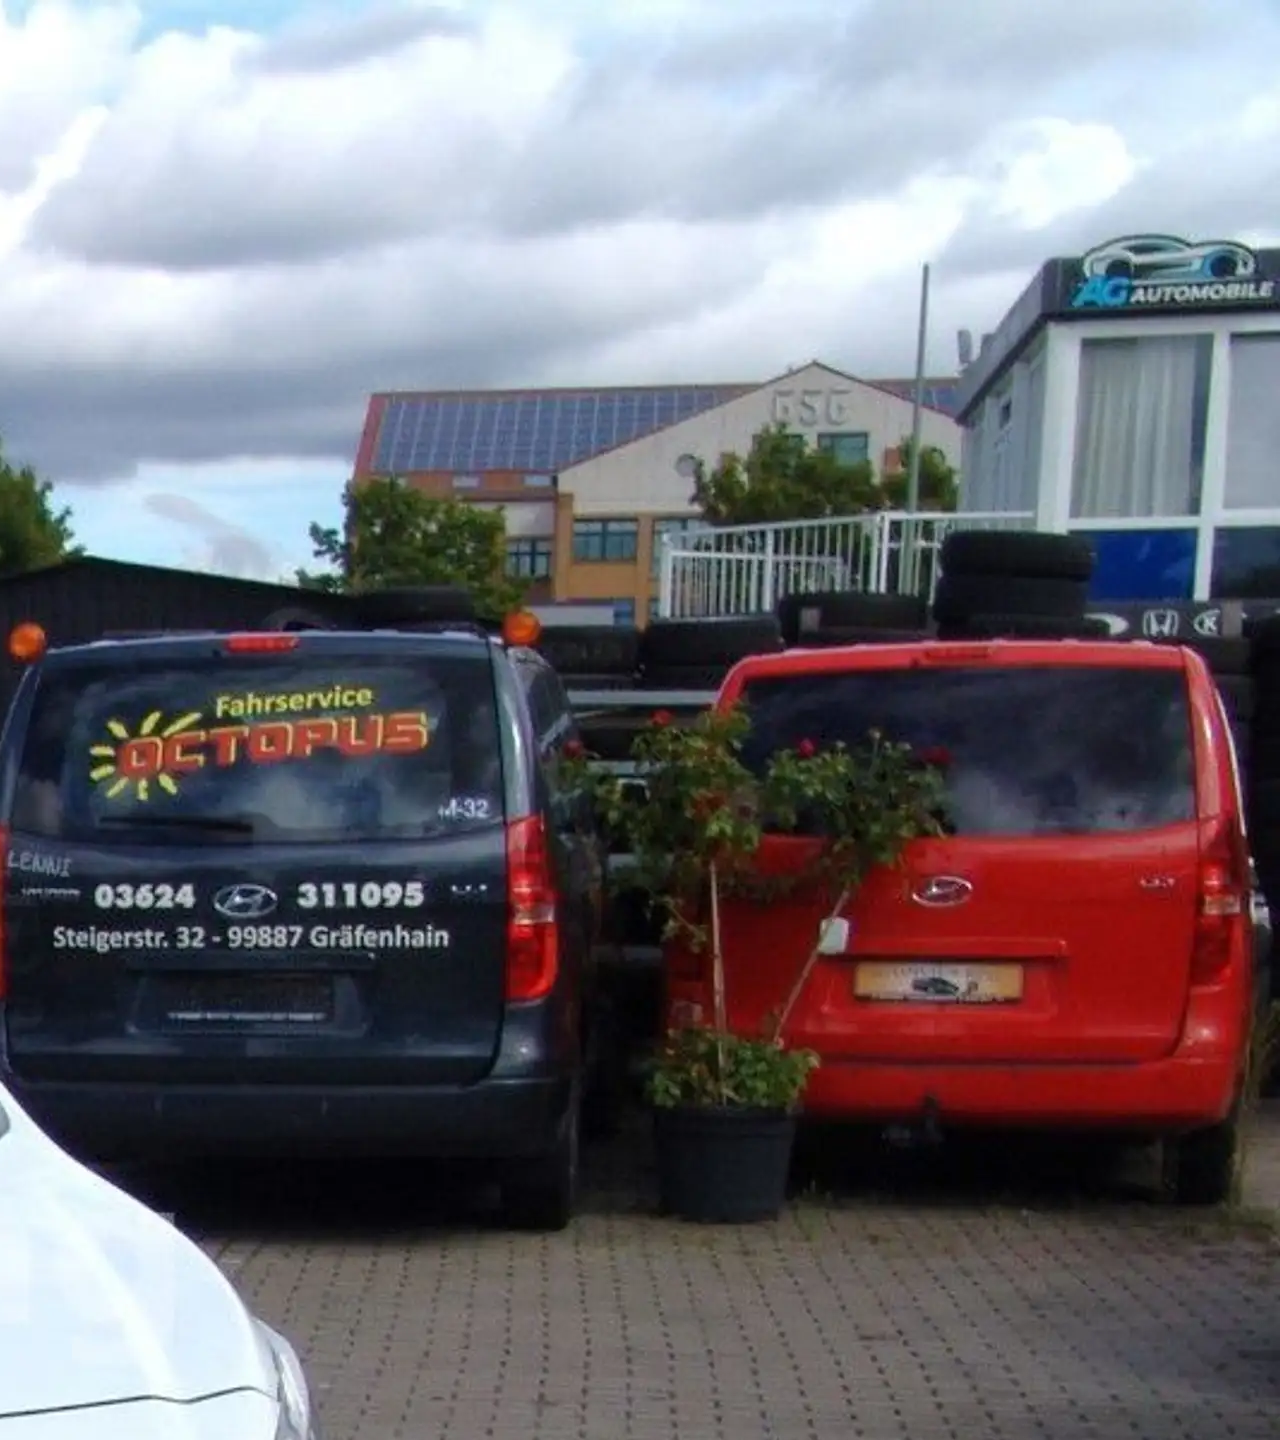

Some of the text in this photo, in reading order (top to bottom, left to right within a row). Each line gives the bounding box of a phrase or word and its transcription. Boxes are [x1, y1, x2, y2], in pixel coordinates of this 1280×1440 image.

[1072, 275, 1275, 307] AG AUTOMOBILE
[216, 686, 372, 718] Fahrservice
[117, 711, 429, 777] OCTOPUS
[94, 883, 196, 909] 03624
[297, 881, 425, 909] 311095
[53, 926, 169, 953] Steigerstr.
[175, 926, 206, 949] 32
[227, 925, 303, 948] 99887
[309, 923, 450, 949] Gräfenhain
